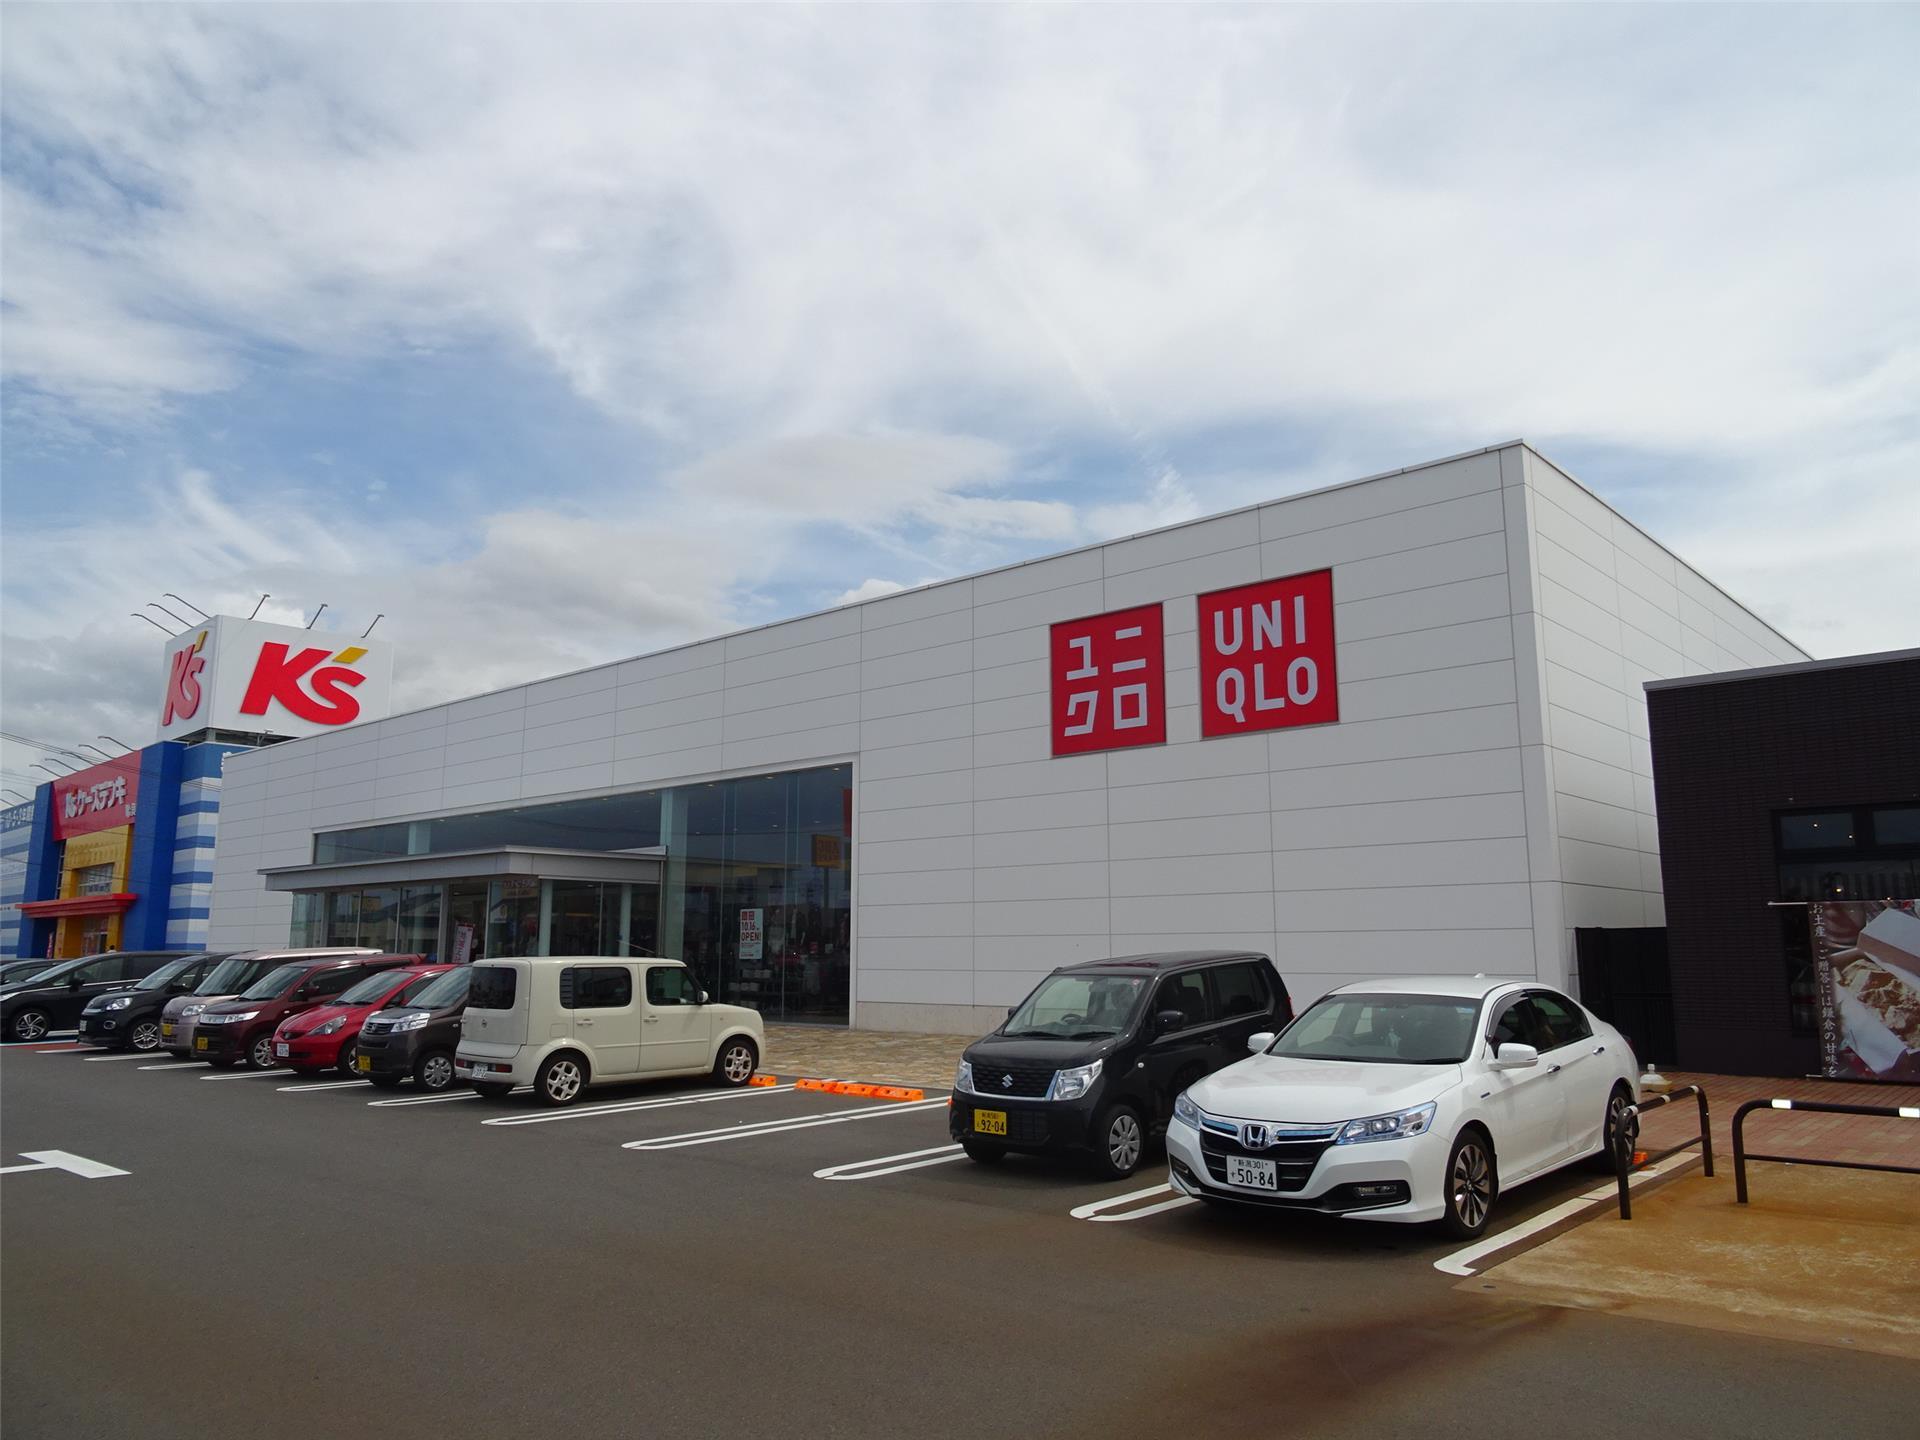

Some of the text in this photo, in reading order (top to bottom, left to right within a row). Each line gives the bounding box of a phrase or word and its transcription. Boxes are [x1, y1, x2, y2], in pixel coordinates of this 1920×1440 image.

[1213, 595, 1306, 656] UNI
[1066, 626, 1147, 681] ユニ
[239, 641, 369, 726] K's
[1064, 682, 1148, 737] クロ
[1216, 656, 1319, 724] QLO
[981, 1119, 1005, 1134] 92-04
[1237, 1168, 1275, 1188] 50-84
